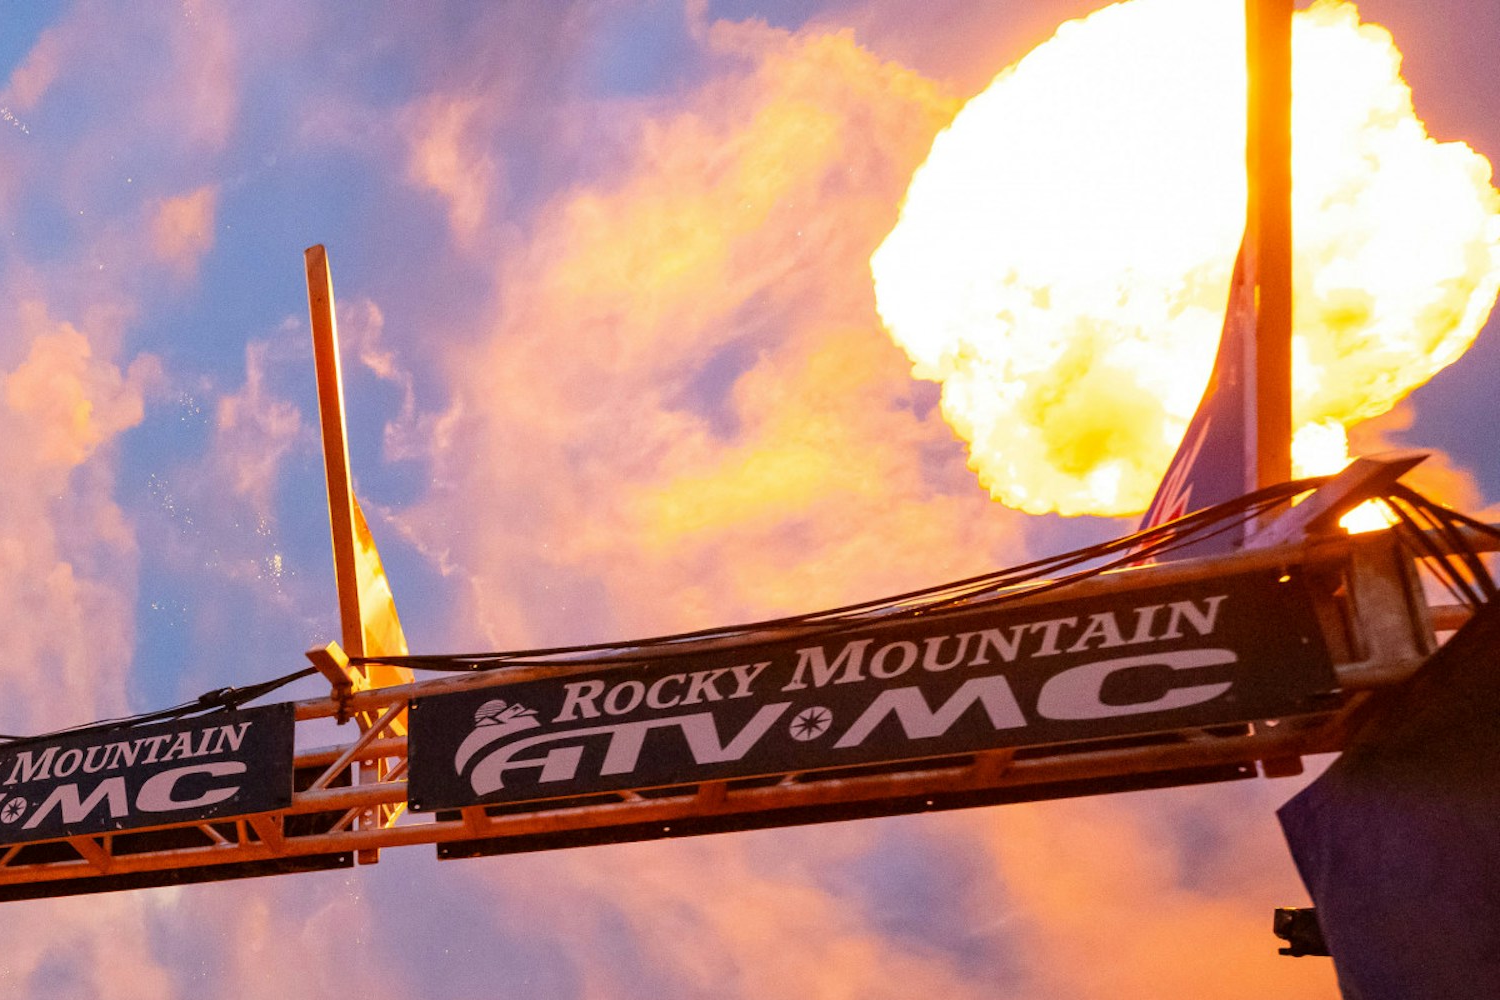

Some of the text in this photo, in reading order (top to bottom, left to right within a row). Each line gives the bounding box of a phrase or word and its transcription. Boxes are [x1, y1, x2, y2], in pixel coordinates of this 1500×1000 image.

[553, 596, 1228, 724] ROCKY MOUNTAIN
[3, 721, 252, 787] MOUNTAIN
